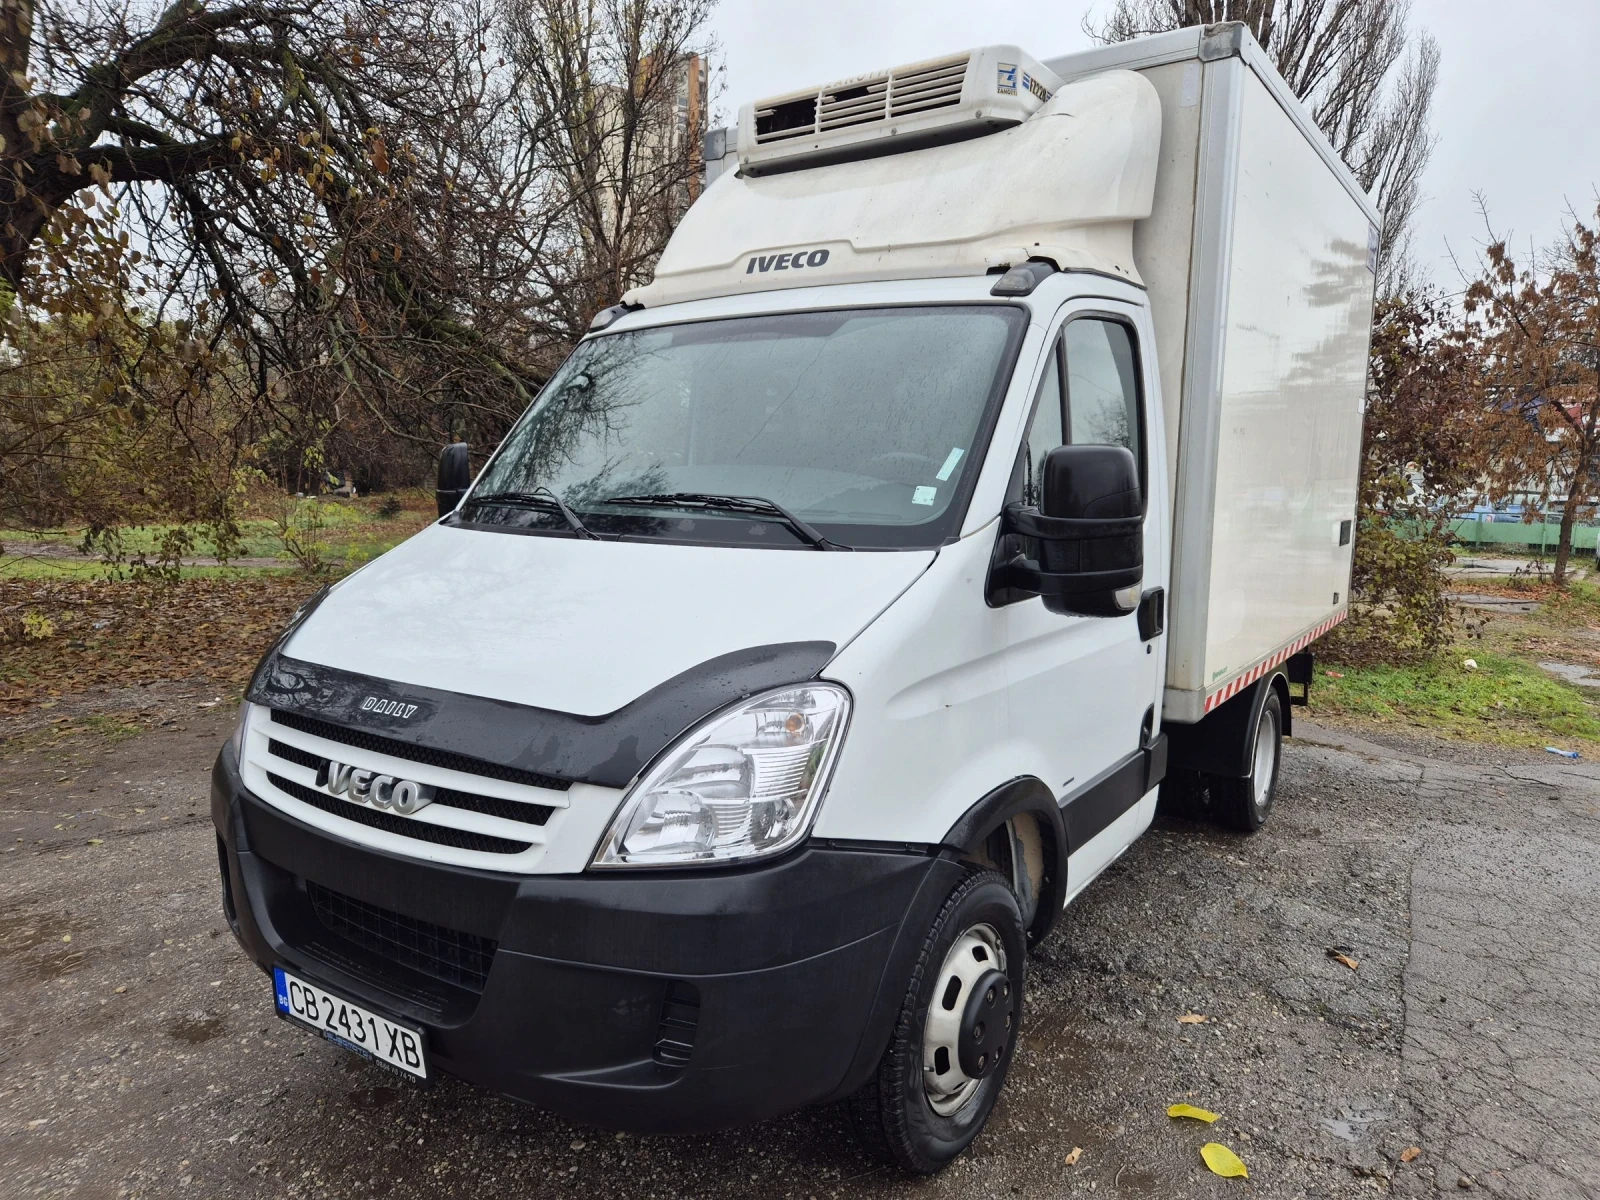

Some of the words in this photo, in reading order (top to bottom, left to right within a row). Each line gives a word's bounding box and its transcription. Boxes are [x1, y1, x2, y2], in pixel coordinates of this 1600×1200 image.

[746, 249, 830, 274] IVECO
[361, 696, 418, 719] DAILY
[278, 994, 288, 1007] BG
